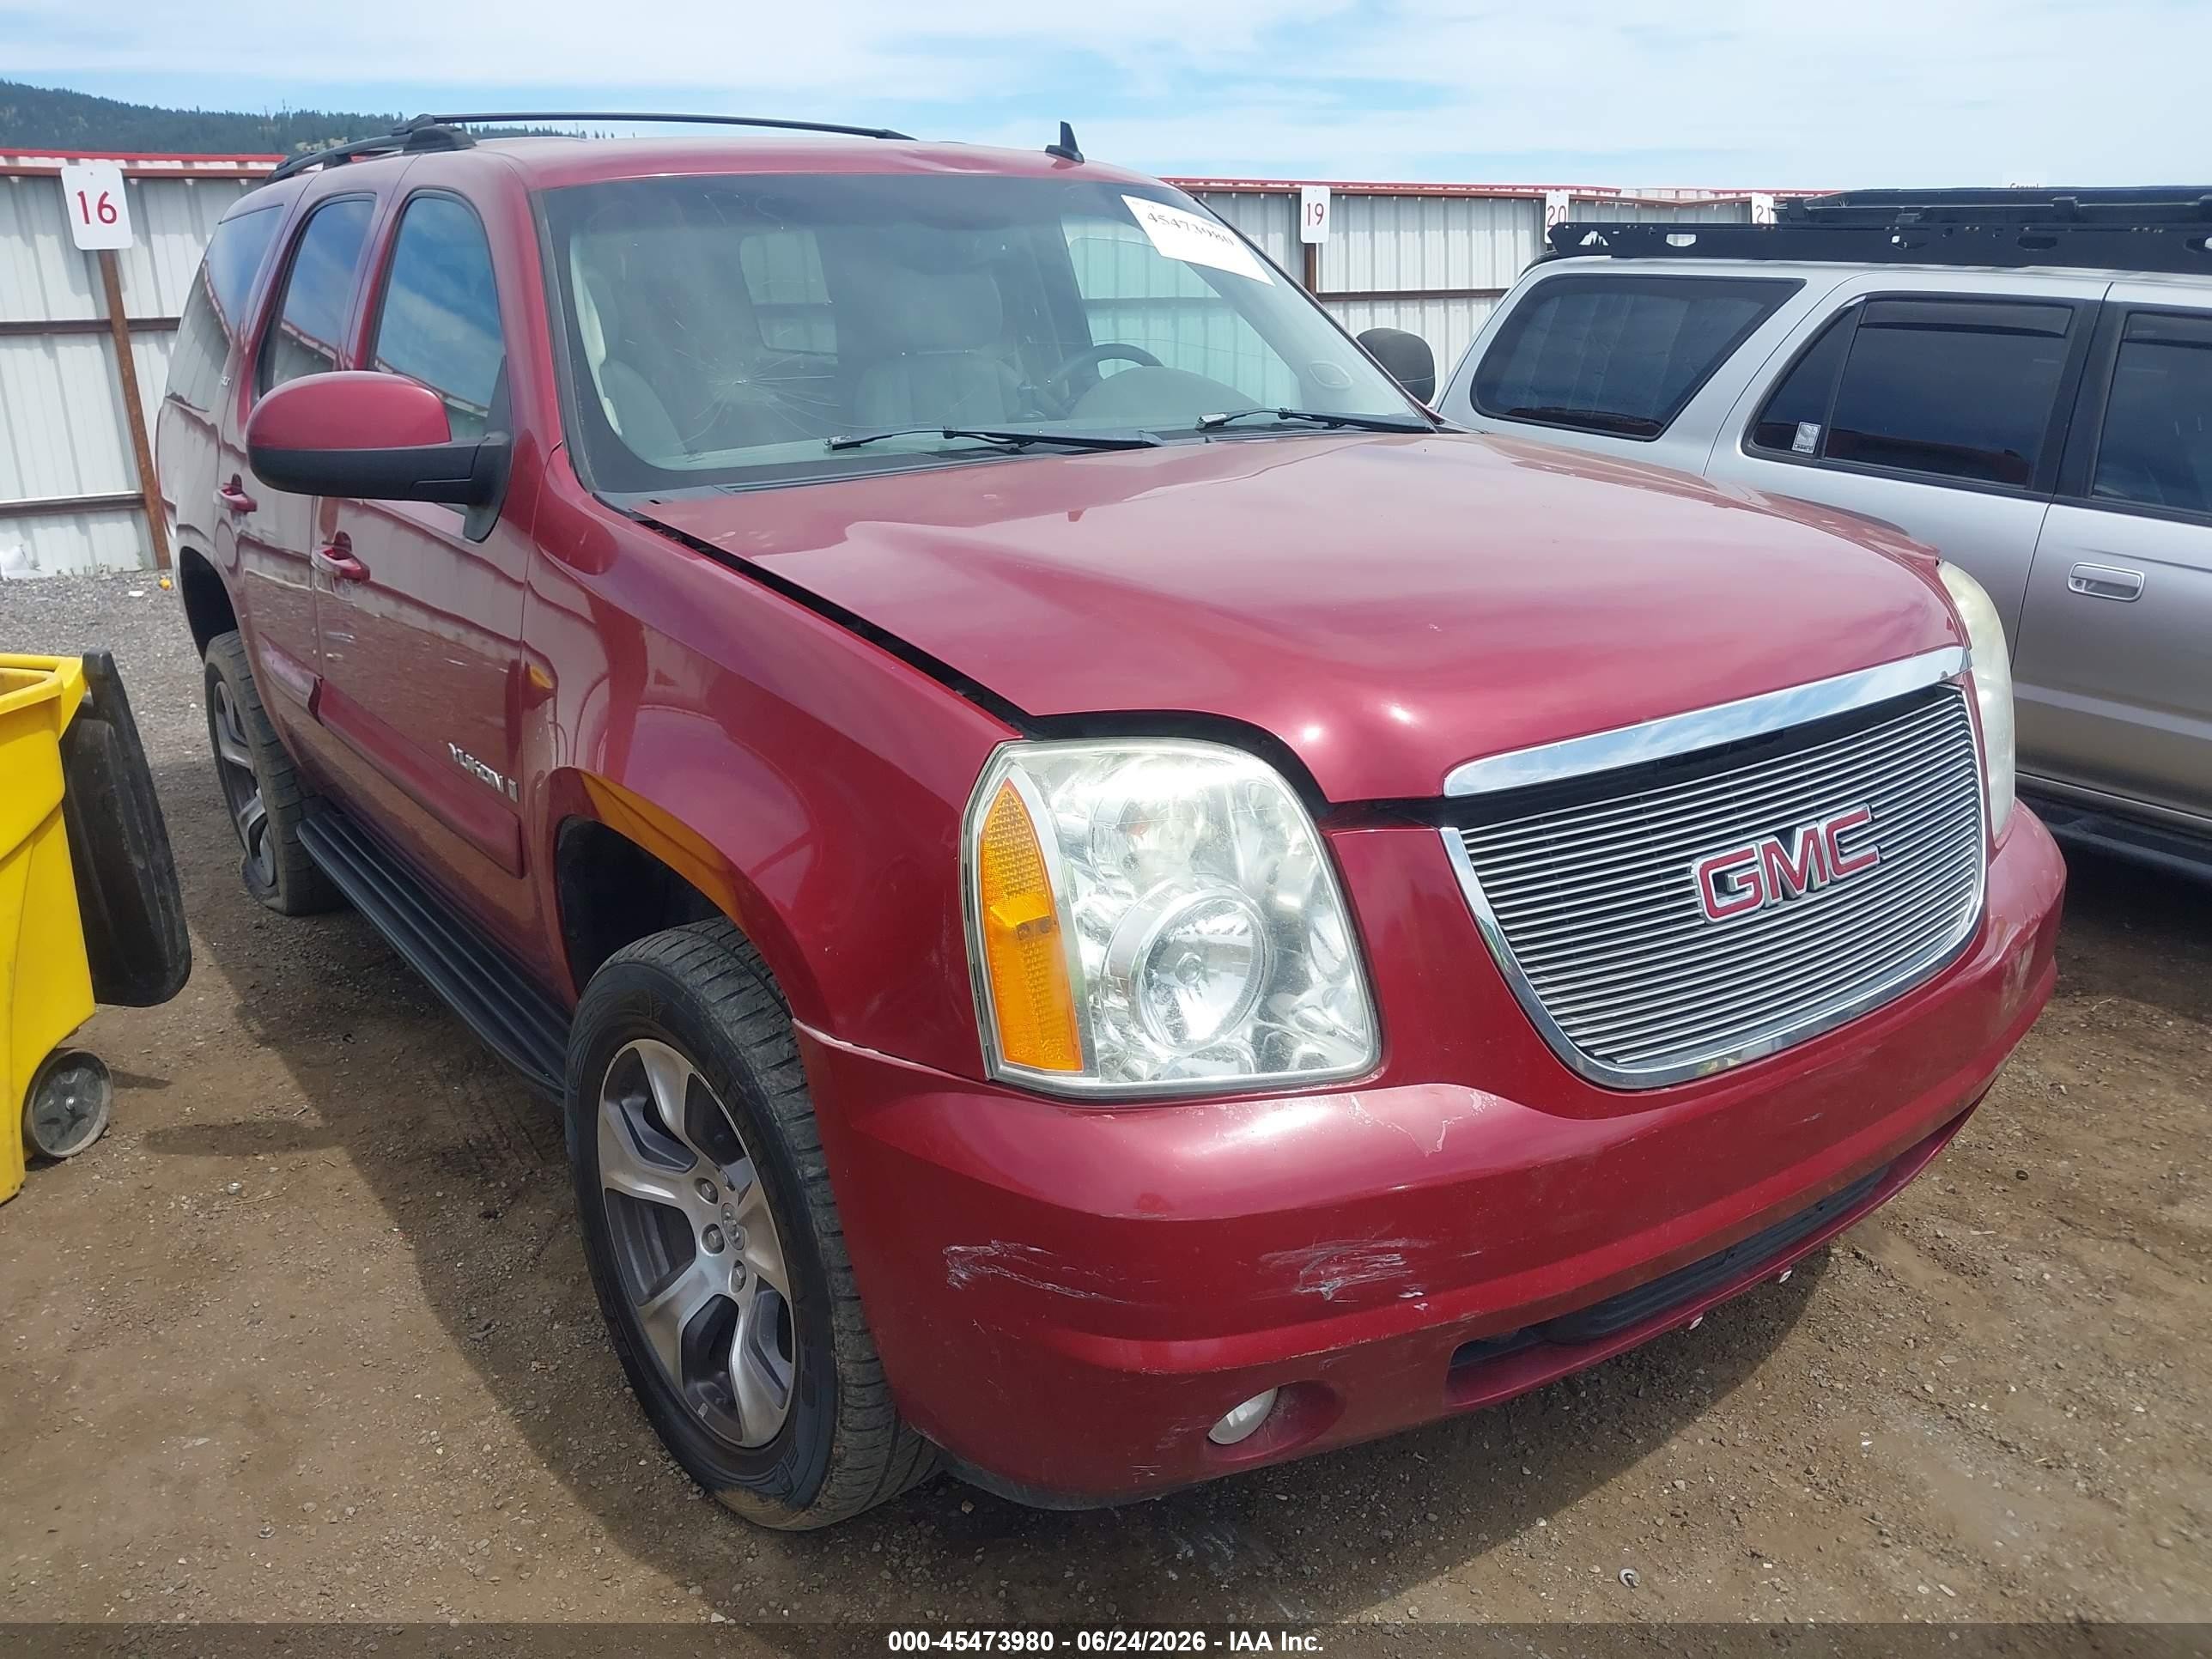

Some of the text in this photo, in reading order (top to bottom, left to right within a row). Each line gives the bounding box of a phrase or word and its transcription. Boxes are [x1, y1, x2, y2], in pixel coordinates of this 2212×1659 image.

[77, 191, 117, 224] 16
[1307, 203, 1324, 226] 19
[1547, 205, 1566, 228] 20
[1756, 204, 1771, 223] 21
[1692, 803, 1881, 923] GMC
